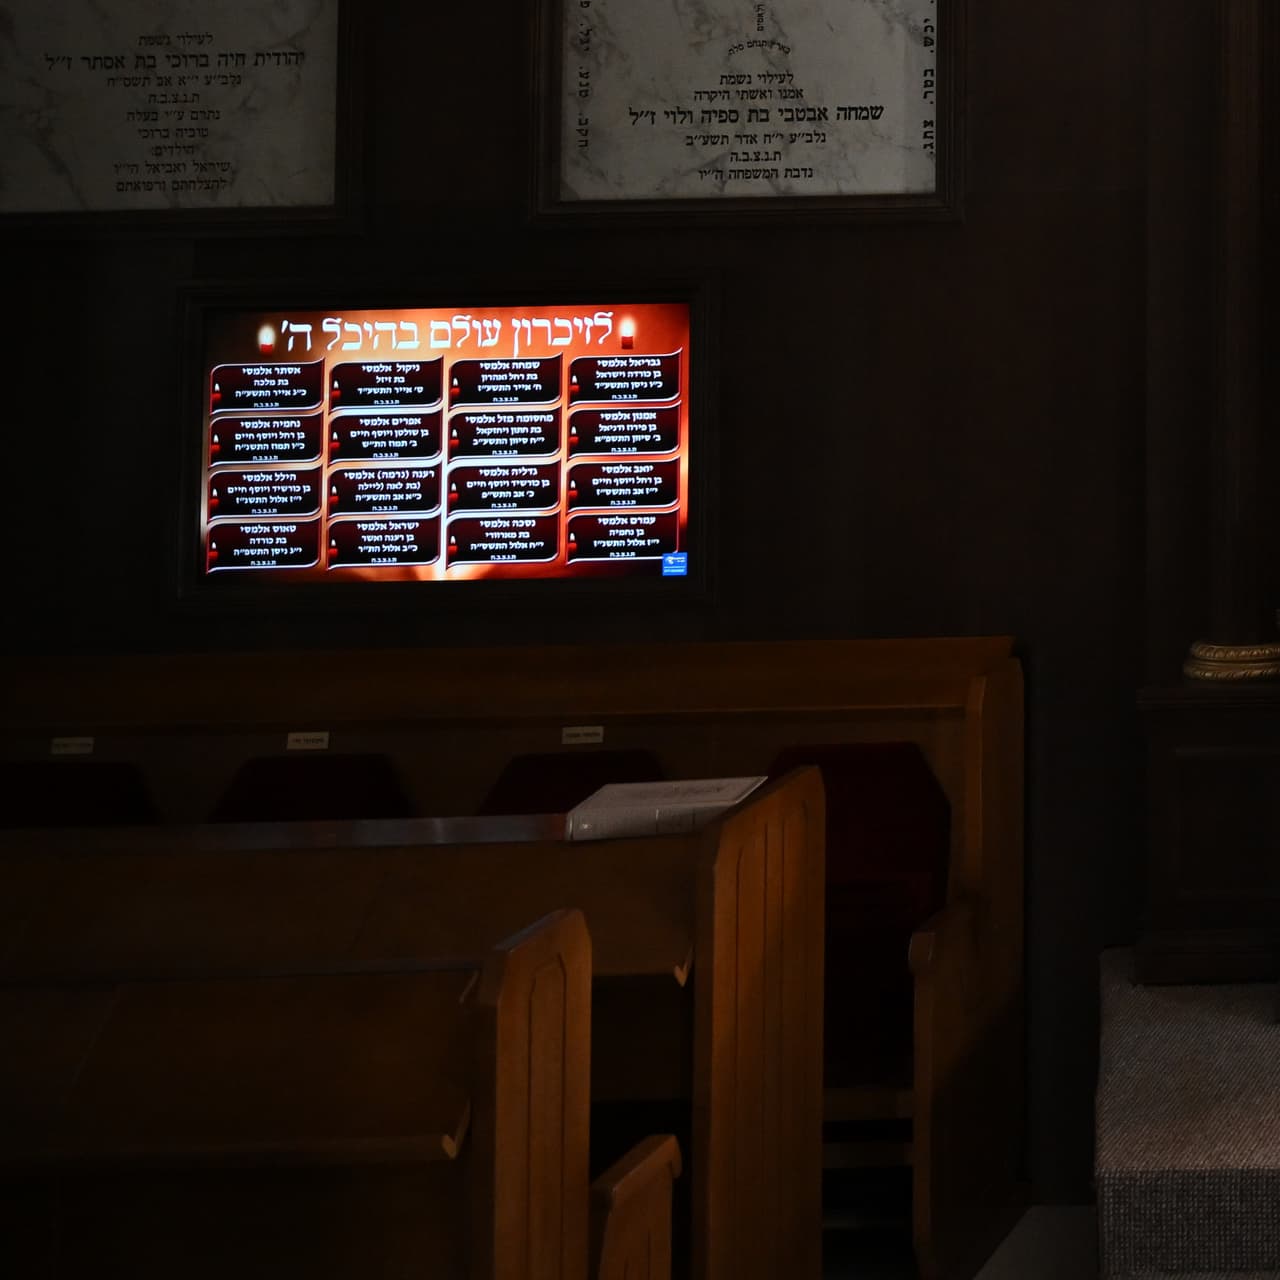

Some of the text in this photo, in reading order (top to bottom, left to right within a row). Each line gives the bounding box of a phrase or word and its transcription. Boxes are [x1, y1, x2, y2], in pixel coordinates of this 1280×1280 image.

[663, 105, 694, 125] ולוי
[700, 108, 740, 125] ספיה
[746, 108, 771, 124] בת
[777, 106, 829, 123] אבטבי
[836, 104, 885, 121] שמחה
[280, 312, 614, 358] לזיכרון עולם בהיכל ה'
